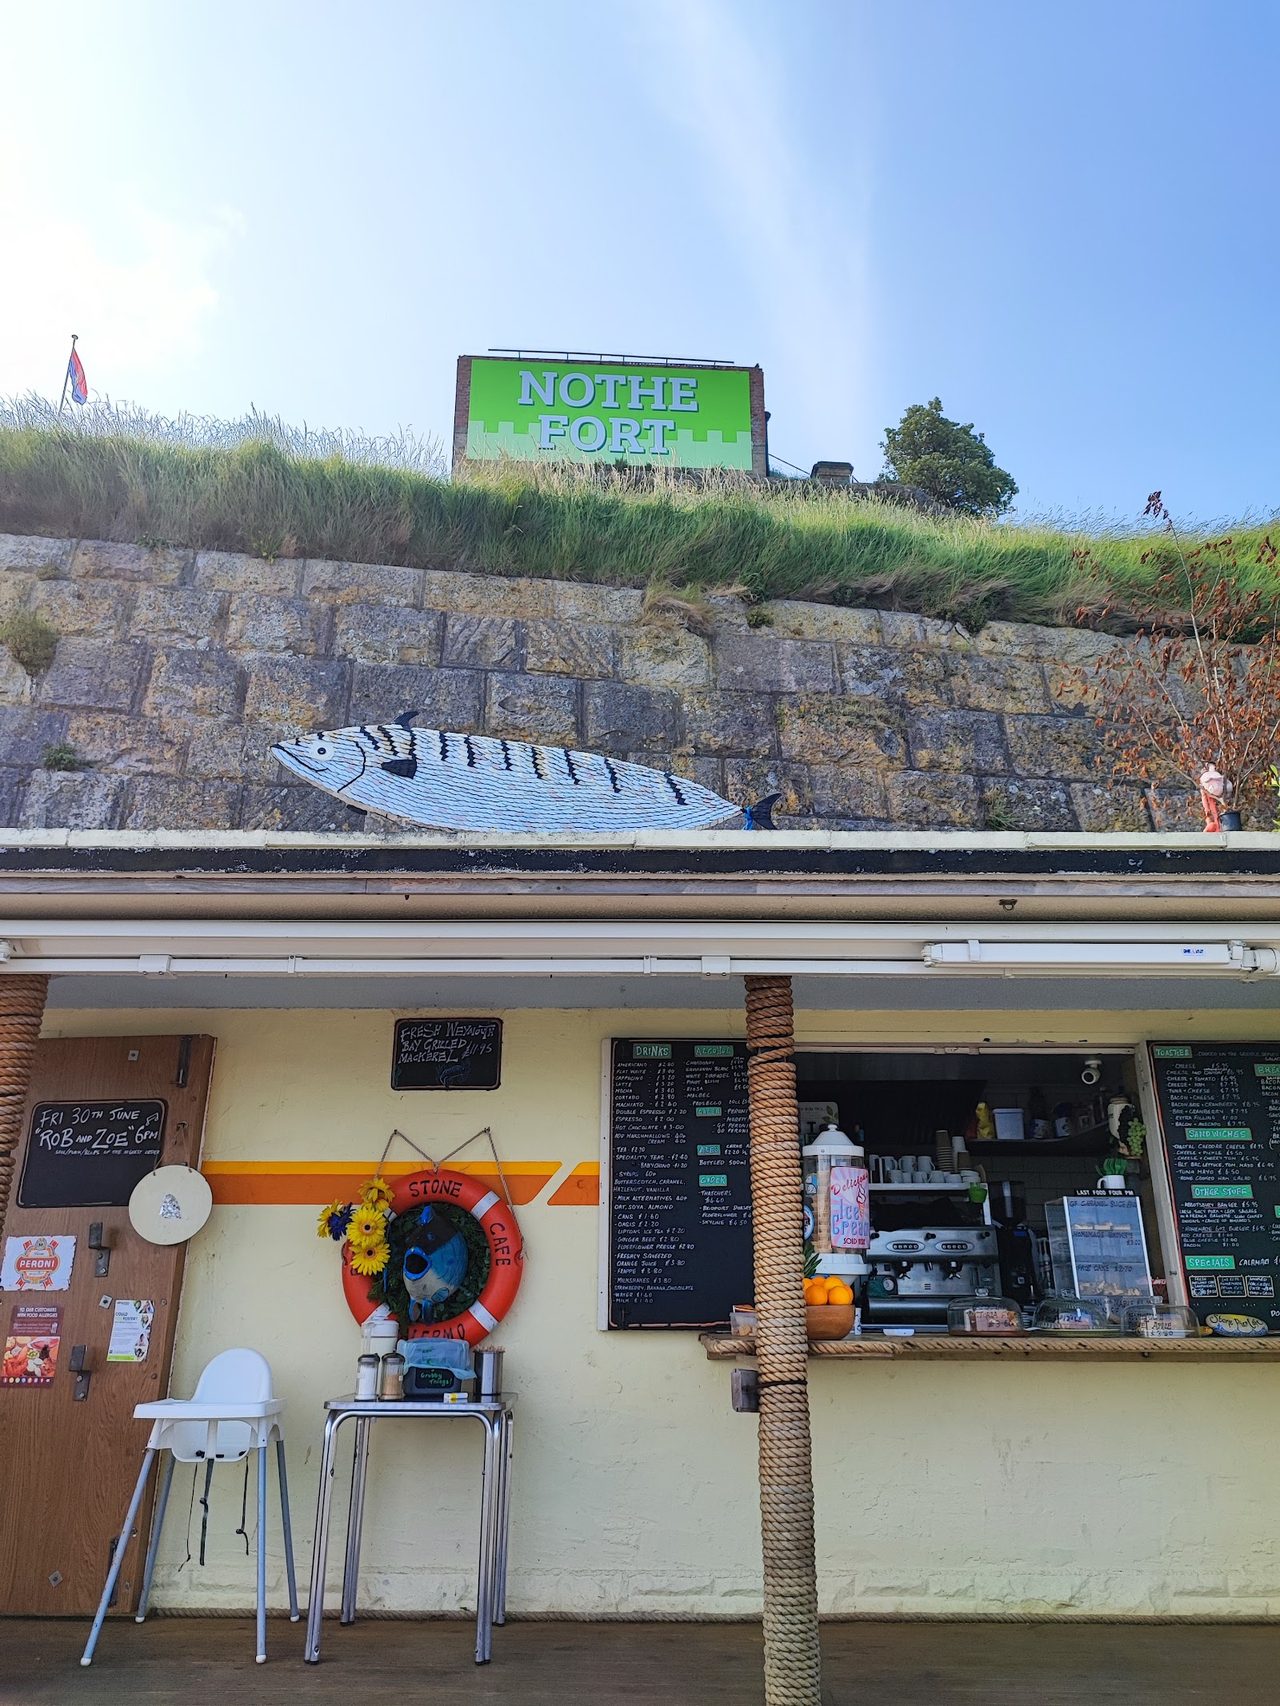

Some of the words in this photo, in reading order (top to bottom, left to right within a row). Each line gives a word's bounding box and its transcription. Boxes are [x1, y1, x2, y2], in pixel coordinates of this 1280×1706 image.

[517, 370, 699, 412] NOTHE
[538, 414, 676, 455] FORT
[400, 1024, 441, 1043] FRESH
[402, 1039, 420, 1052] BAY
[423, 1038, 467, 1052] GRILLED
[636, 1046, 669, 1057] DRINKS
[398, 1050, 459, 1064] MACKEREL
[40, 1109, 64, 1128] FRI
[72, 1107, 103, 1124] 30TH
[109, 1108, 140, 1120] JUNE
[76, 1135, 93, 1143] AND
[135, 1125, 158, 1144] 6PM
[1188, 1130, 1246, 1138] SANDWICHES
[408, 1179, 463, 1198] STONE
[1194, 1187, 1219, 1196] OTHER
[1222, 1187, 1247, 1196] STUFF
[839, 1199, 860, 1220] Ice
[489, 1222, 511, 1267] CAFE
[1189, 1258, 1230, 1267] SPECIALS
